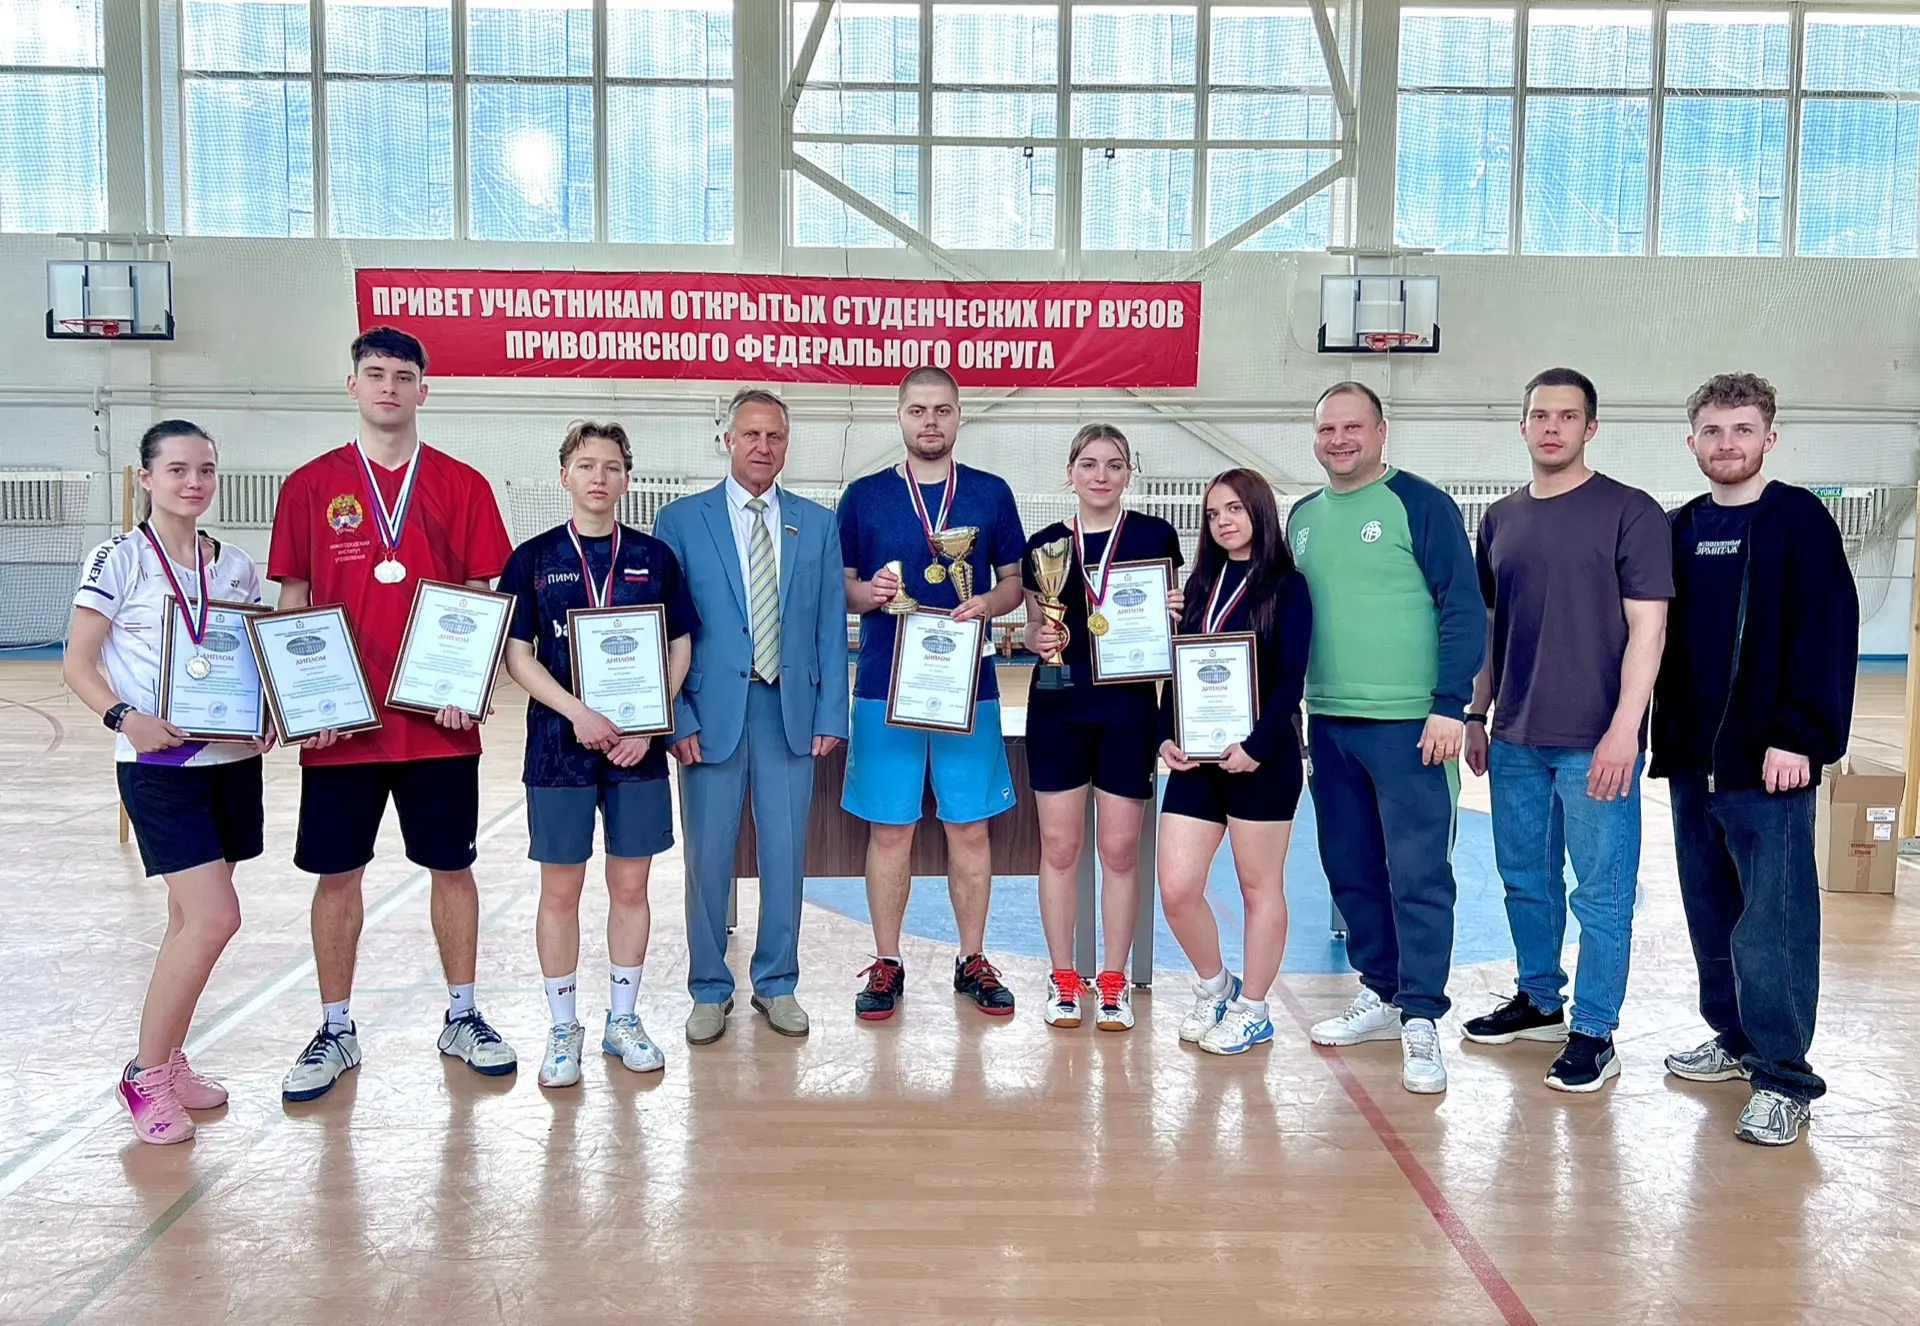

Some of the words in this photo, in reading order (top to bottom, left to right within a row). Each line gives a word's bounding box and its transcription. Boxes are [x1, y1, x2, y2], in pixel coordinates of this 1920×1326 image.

[372, 286, 474, 317] ПРИВЕТ
[479, 288, 663, 319] УЧАСТНИКАМ
[671, 290, 827, 324] ОТКРЫТЫХ
[832, 295, 1039, 331] СТУДЕНЧЕСКИХ
[1045, 298, 1093, 329] ИГР
[1098, 298, 1184, 329] ВУЗОВ
[505, 330, 729, 362] ПРИВОЛЖСКОГО
[735, 334, 951, 369] ФЕДЕРАЛЬНОГО
[957, 339, 1055, 370] ОКРУГА
[87, 546, 114, 583] YONEX
[547, 572, 580, 584] ПИМУ
[296, 655, 326, 665] ДИПЛОМ
[605, 656, 635, 664] ДИПЛОМ
